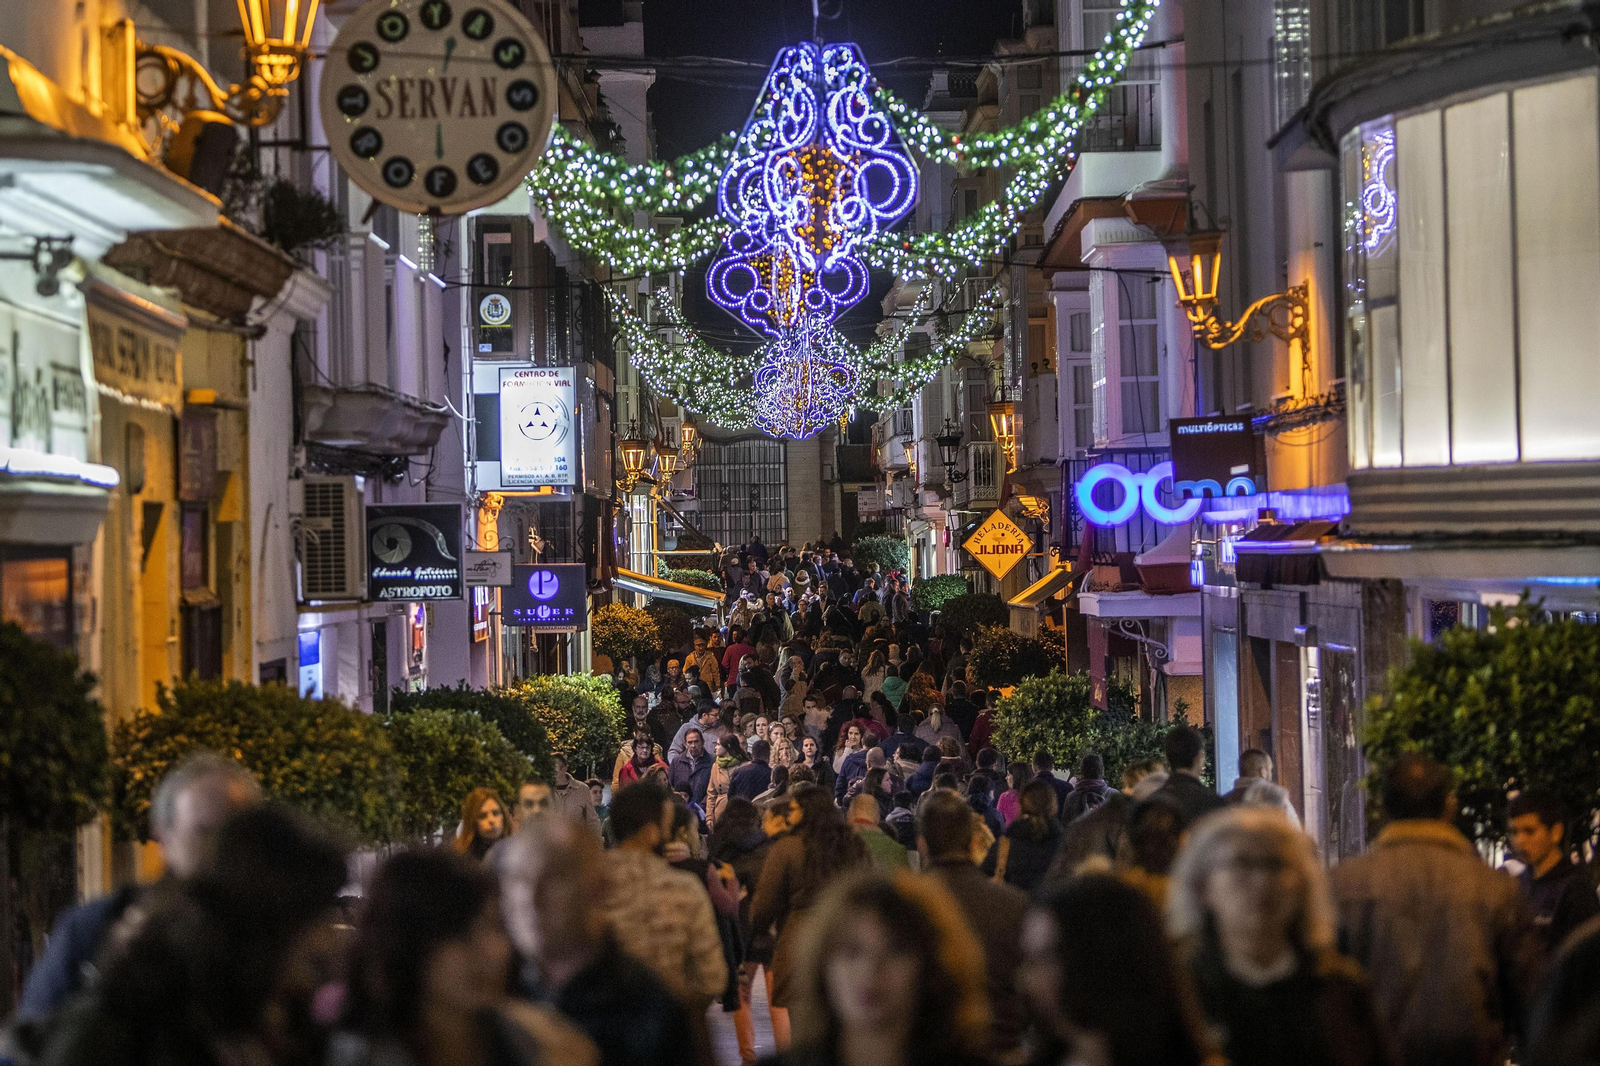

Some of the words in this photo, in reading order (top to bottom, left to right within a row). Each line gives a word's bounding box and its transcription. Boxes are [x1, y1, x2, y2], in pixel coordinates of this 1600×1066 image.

[375, 76, 498, 119] SERVAN
[514, 370, 546, 378] CENTRO
[554, 379, 571, 387] VIAL
[973, 522, 1024, 544] HELADERIA
[975, 544, 1024, 555] JIJONA
[372, 566, 412, 578] Eduardo
[379, 585, 453, 598] ASTROFOTO
[513, 604, 574, 618] SUPER
